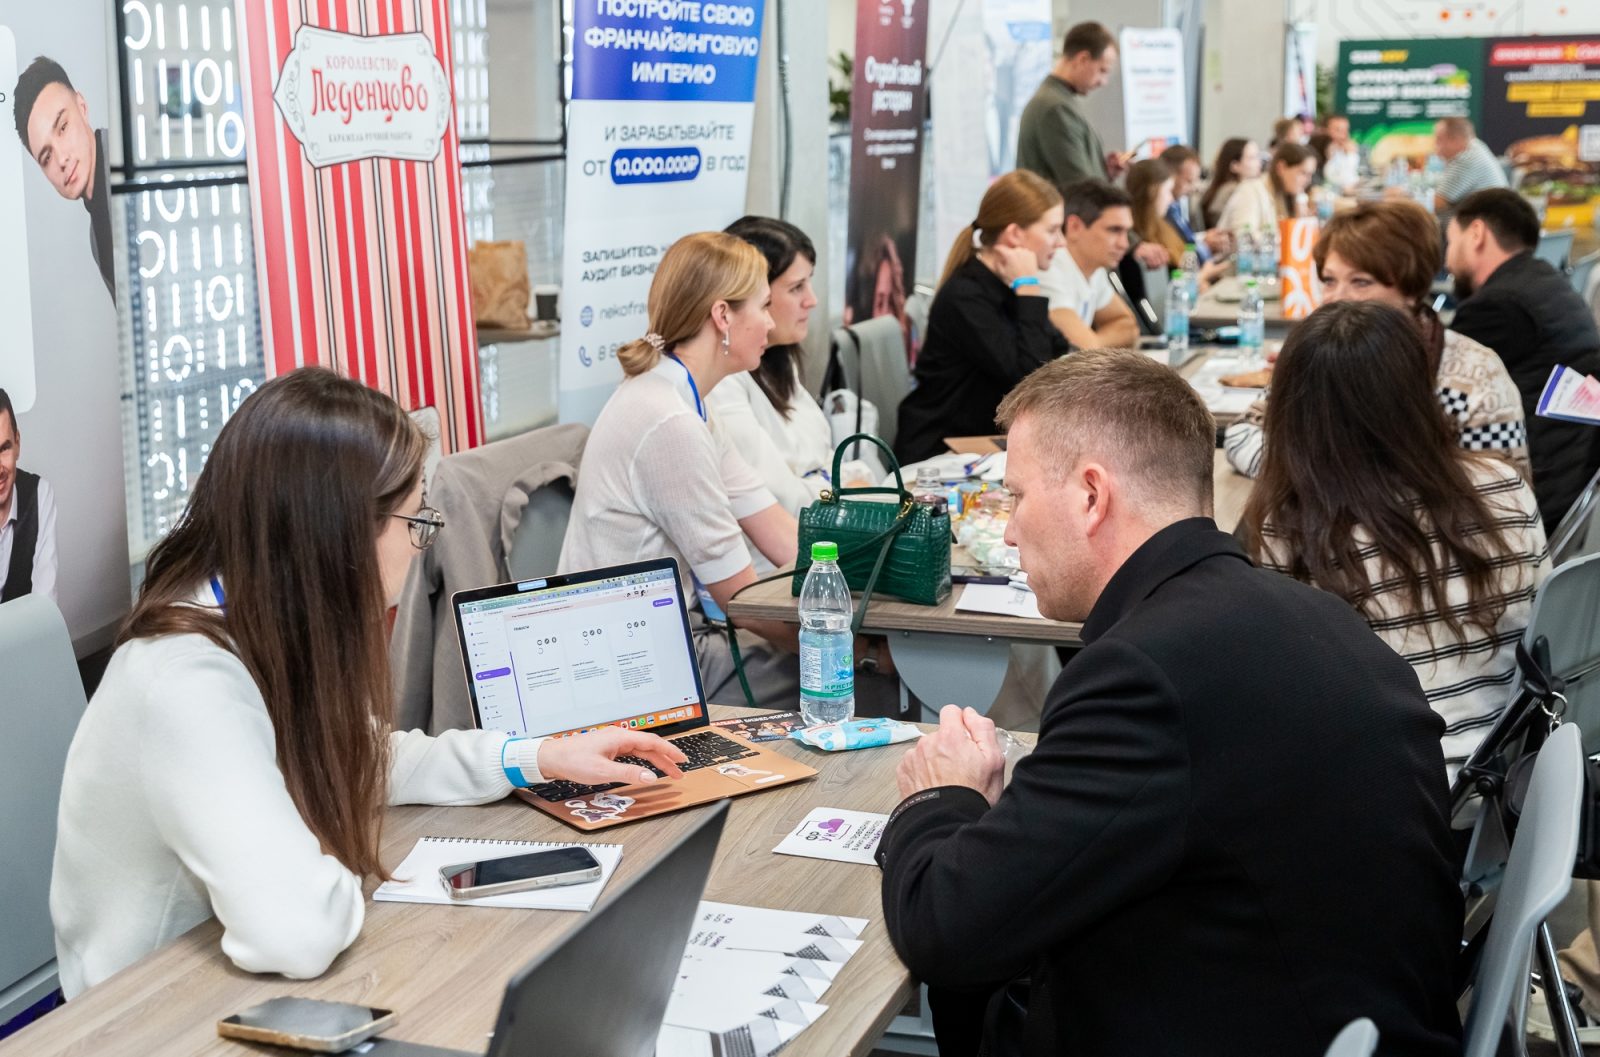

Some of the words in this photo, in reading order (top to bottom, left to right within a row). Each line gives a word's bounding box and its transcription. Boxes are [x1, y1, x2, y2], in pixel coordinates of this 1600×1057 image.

[597, 0, 701, 22] ПОСТРОЙТЕ
[703, 3, 755, 27] СВОЮ
[584, 25, 758, 57] ФРАНЧАЙЗИНГОВУЮ
[326, 55, 399, 71] КОРОЛЕВСТВО
[631, 61, 717, 84] ИМПЕРИЮ
[311, 64, 429, 125] Леденцово
[605, 126, 616, 140] И
[620, 121, 735, 142] ЗАРАБАТЫВАЙТЕ
[583, 160, 607, 176] ОТ
[706, 155, 717, 171] В
[720, 155, 745, 172] ГОД
[583, 245, 658, 263] ЗАПИШИТЕСЬ
[582, 266, 618, 282] АУДИТ
[621, 262, 660, 277] БИЗНЕ
[600, 300, 648, 320] nekofra
